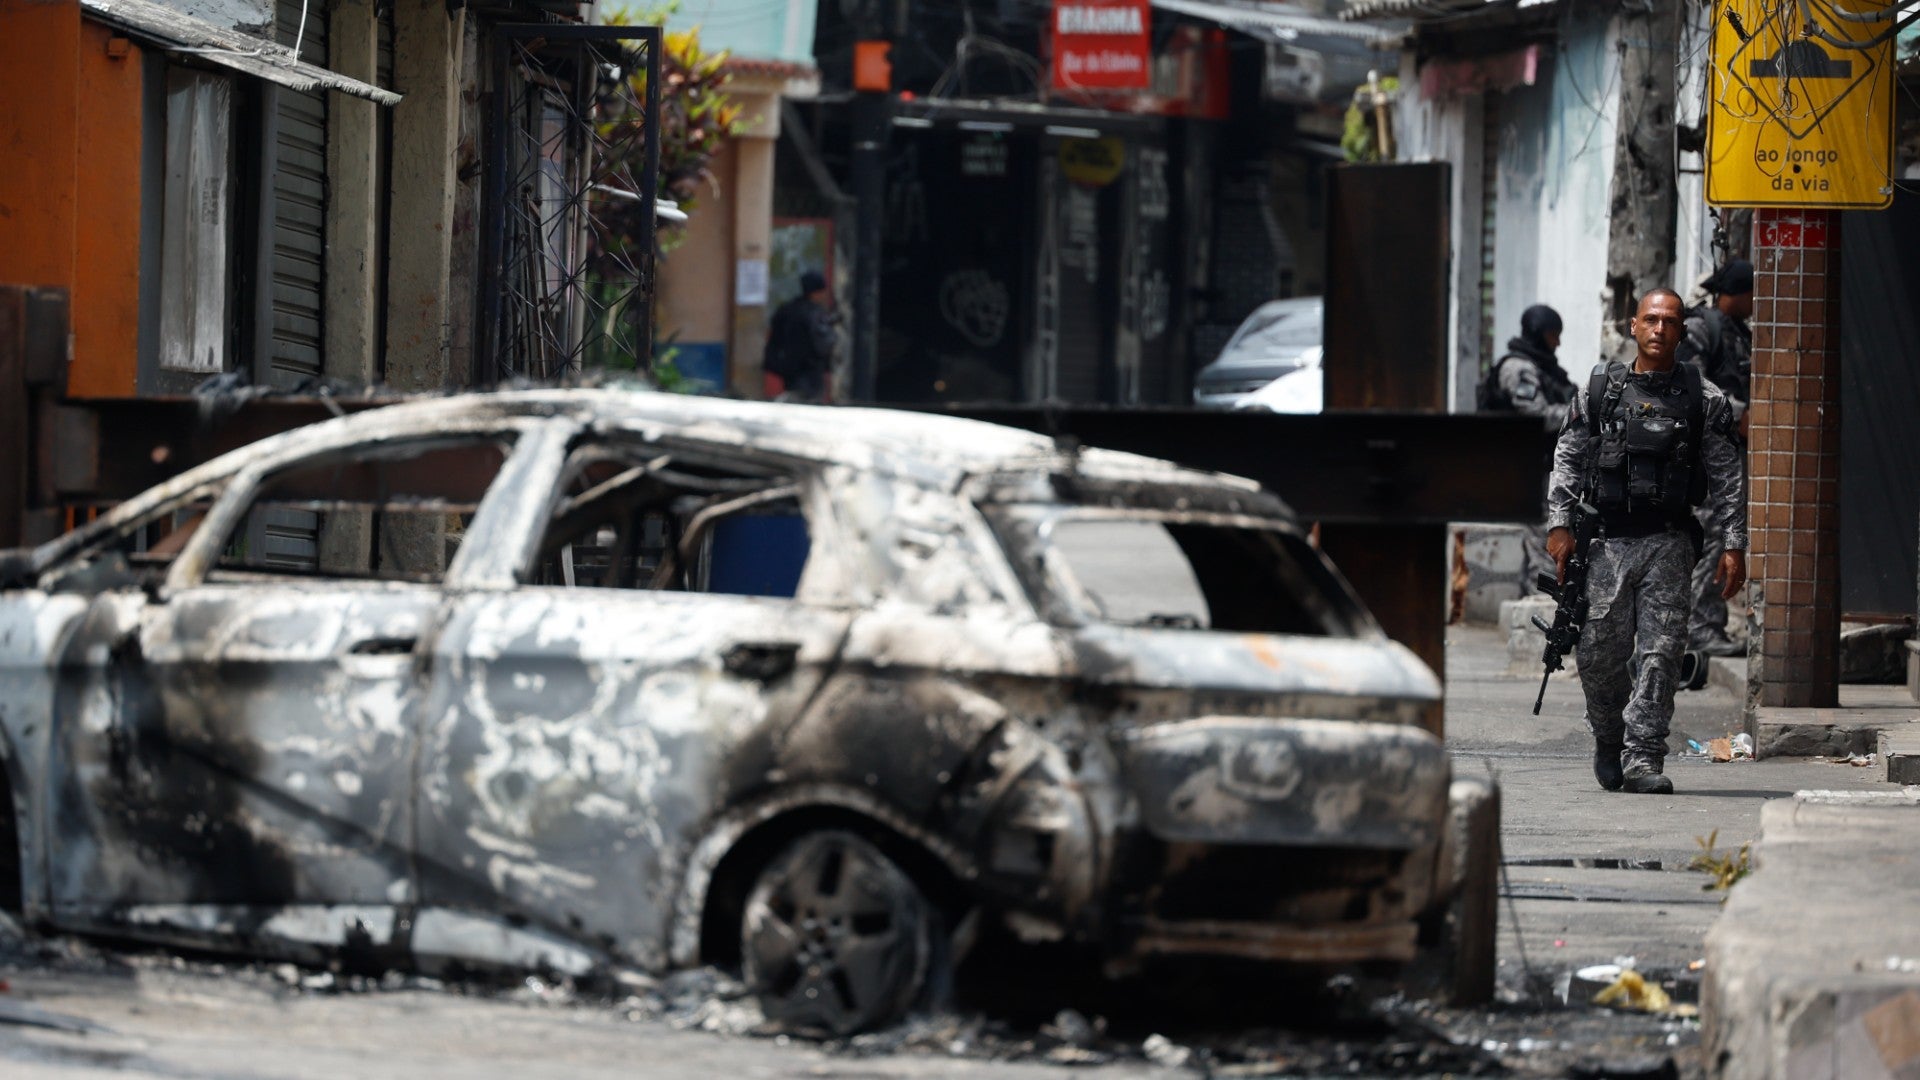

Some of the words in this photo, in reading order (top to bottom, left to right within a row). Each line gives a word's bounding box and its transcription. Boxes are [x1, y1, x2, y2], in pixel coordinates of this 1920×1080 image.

[1058, 7, 1142, 33] BRAHMA
[1757, 149, 1779, 162] ao
[1786, 147, 1838, 167] longo
[1771, 175, 1794, 191] da
[1801, 175, 1830, 191] via
